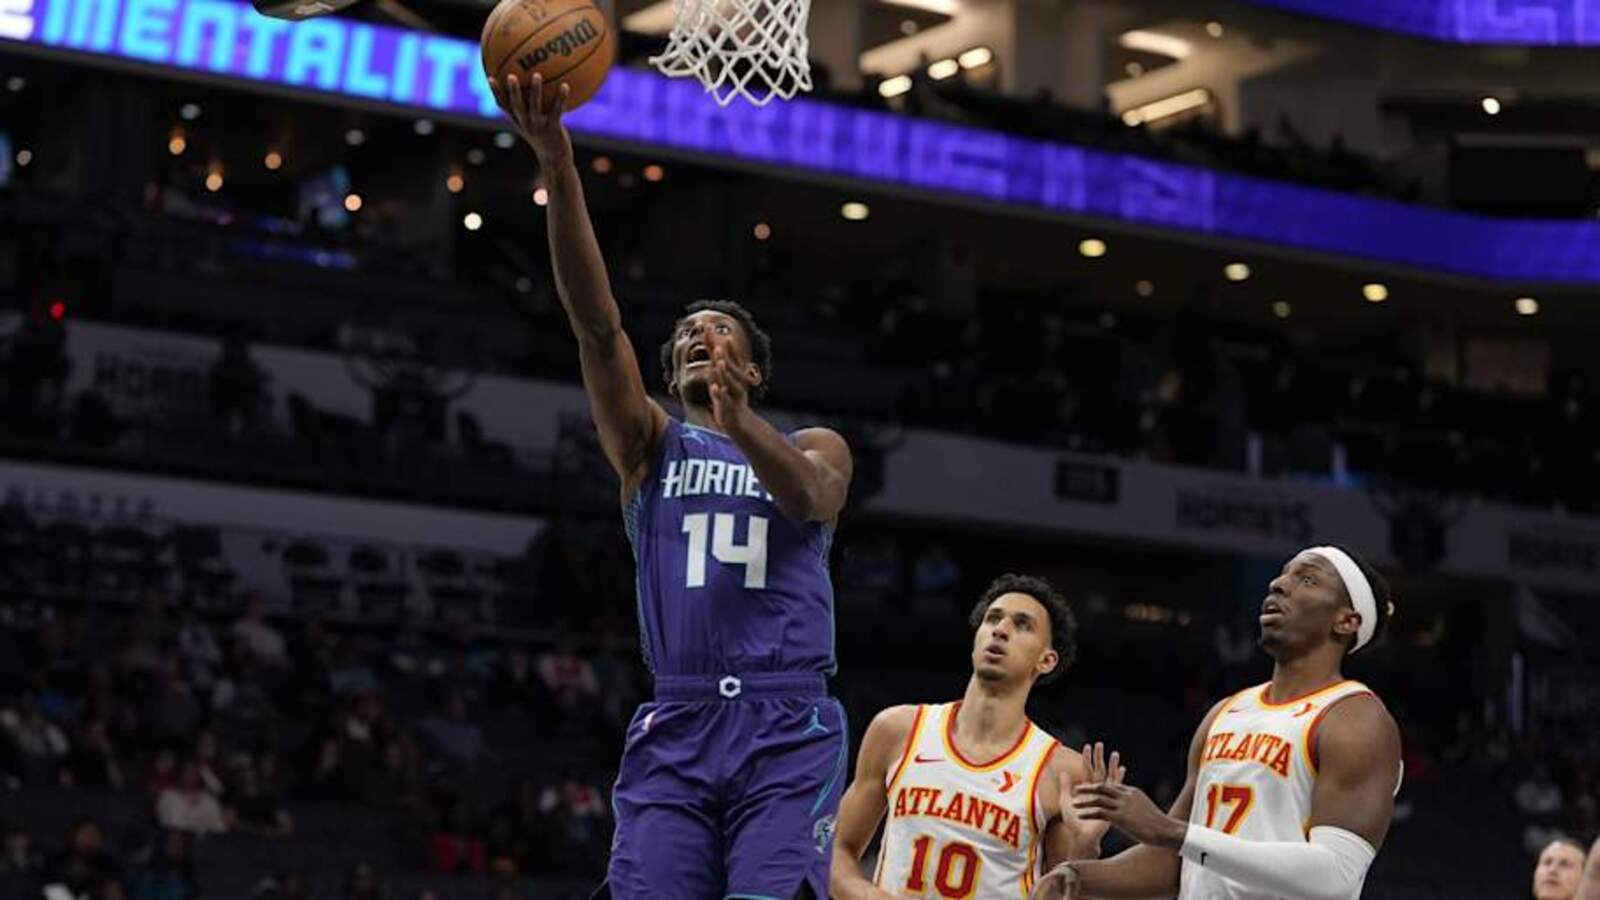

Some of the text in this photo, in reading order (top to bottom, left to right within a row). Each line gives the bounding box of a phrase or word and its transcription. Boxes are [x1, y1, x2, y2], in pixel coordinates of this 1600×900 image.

[519, 18, 599, 70] Wilson
[661, 458, 774, 501] HORNE
[682, 512, 770, 590] 14
[1204, 732, 1291, 777] TLANTA
[894, 787, 1021, 847] ATLANTA
[1206, 783, 1252, 835] 17
[906, 836, 979, 899] 10
